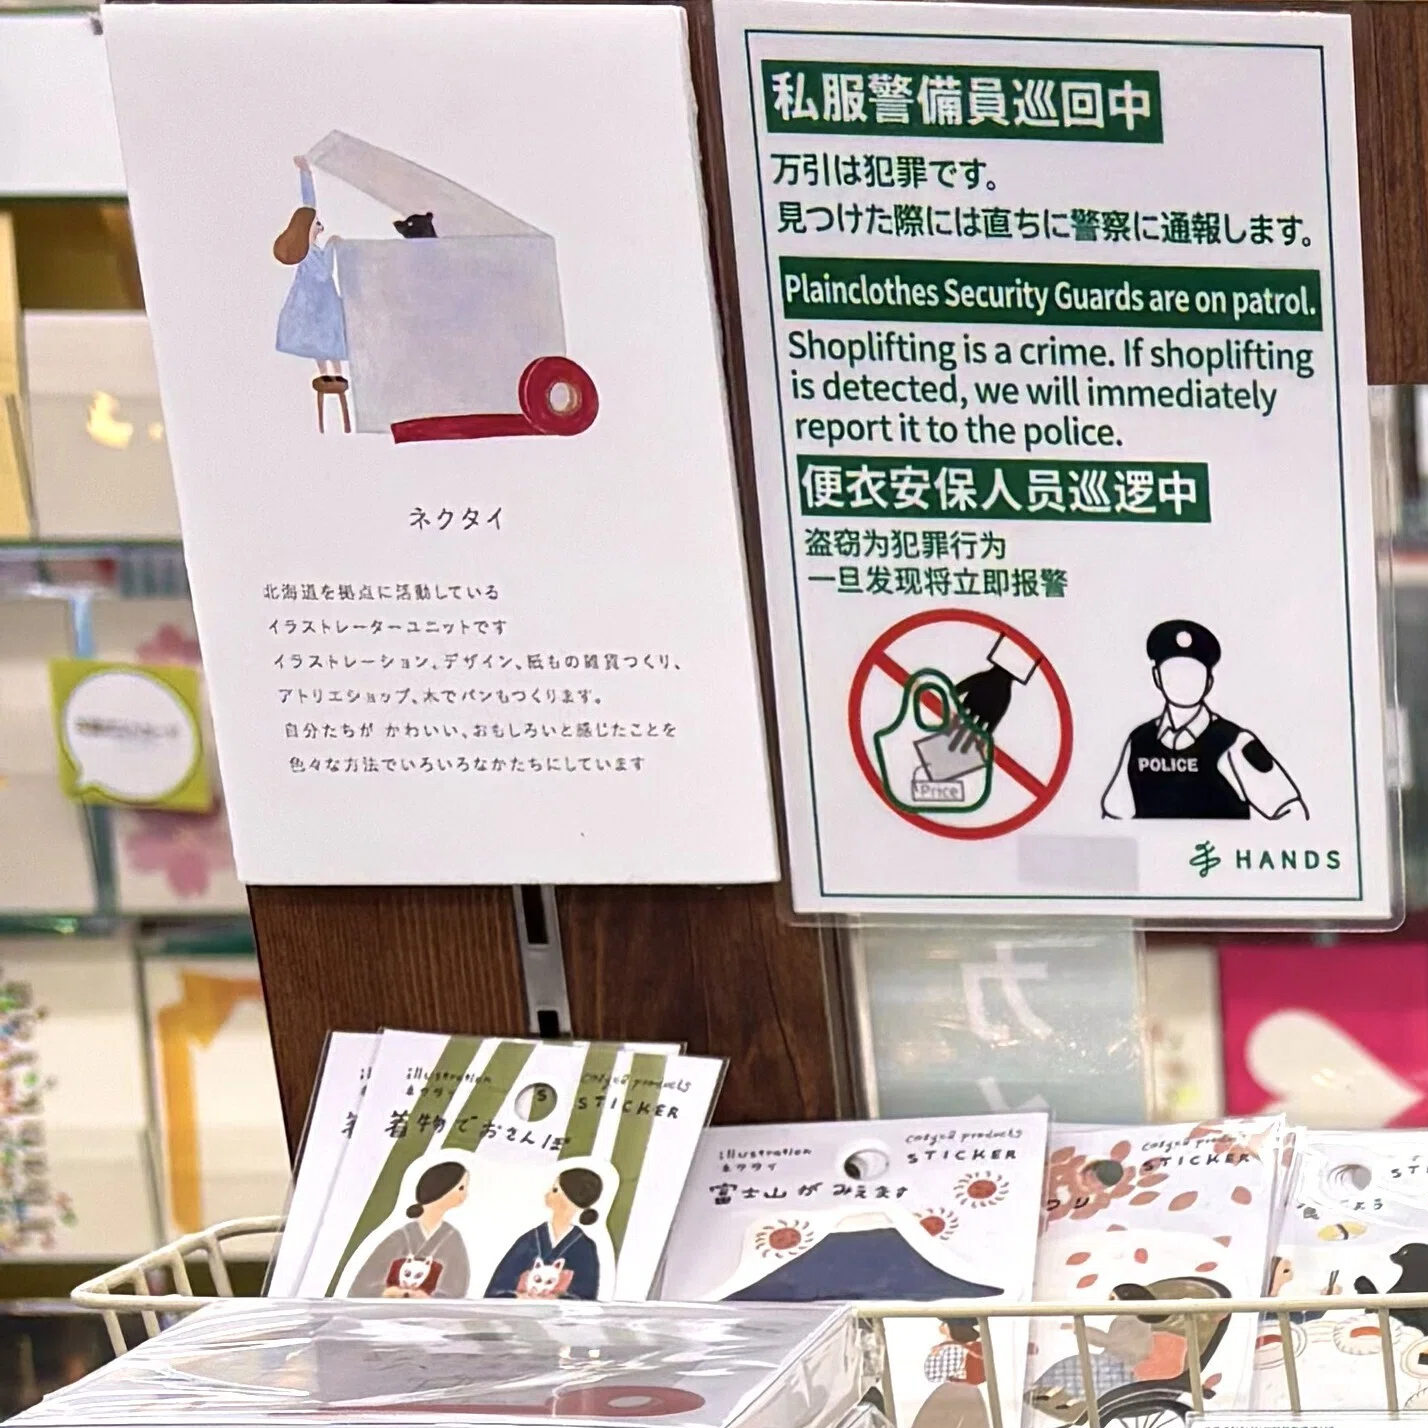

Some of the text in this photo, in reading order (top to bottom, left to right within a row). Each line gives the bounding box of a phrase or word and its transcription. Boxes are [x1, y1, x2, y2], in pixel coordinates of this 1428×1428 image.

[771, 71, 1151, 131] 私服警備員巡回中
[771, 153, 997, 190] 万引は犯罪です。
[776, 203, 1311, 246] 見つけた際には直ちに警察に通報します。
[785, 274, 1316, 320] Plainclothes Security Guards are on patrol.
[788, 333, 1314, 378] Shoplifting is a crime. If shoplifting
[792, 372, 1277, 416] is detected, we will immediately
[795, 415, 1123, 452] report it to the police.
[801, 464, 1198, 515] 便衣安保人员巡逻中
[407, 506, 504, 531] ネクタイ
[804, 529, 1006, 560] 盗窃为犯罪行为
[262, 582, 500, 602] 北海道を拠点に活動している
[807, 568, 1068, 598] 一旦发现将立即报警
[267, 618, 508, 637] イラストレーターユニットです
[284, 722, 374, 740] 自分たちが
[289, 755, 646, 774] 色々な方法でいろいろなかたちにしています
[1139, 757, 1198, 772] POLICE
[919, 782, 959, 799] Price
[1236, 849, 1341, 871] HANDS
[578, 1096, 679, 1119] STICKER
[908, 1149, 1018, 1164] STICKER
